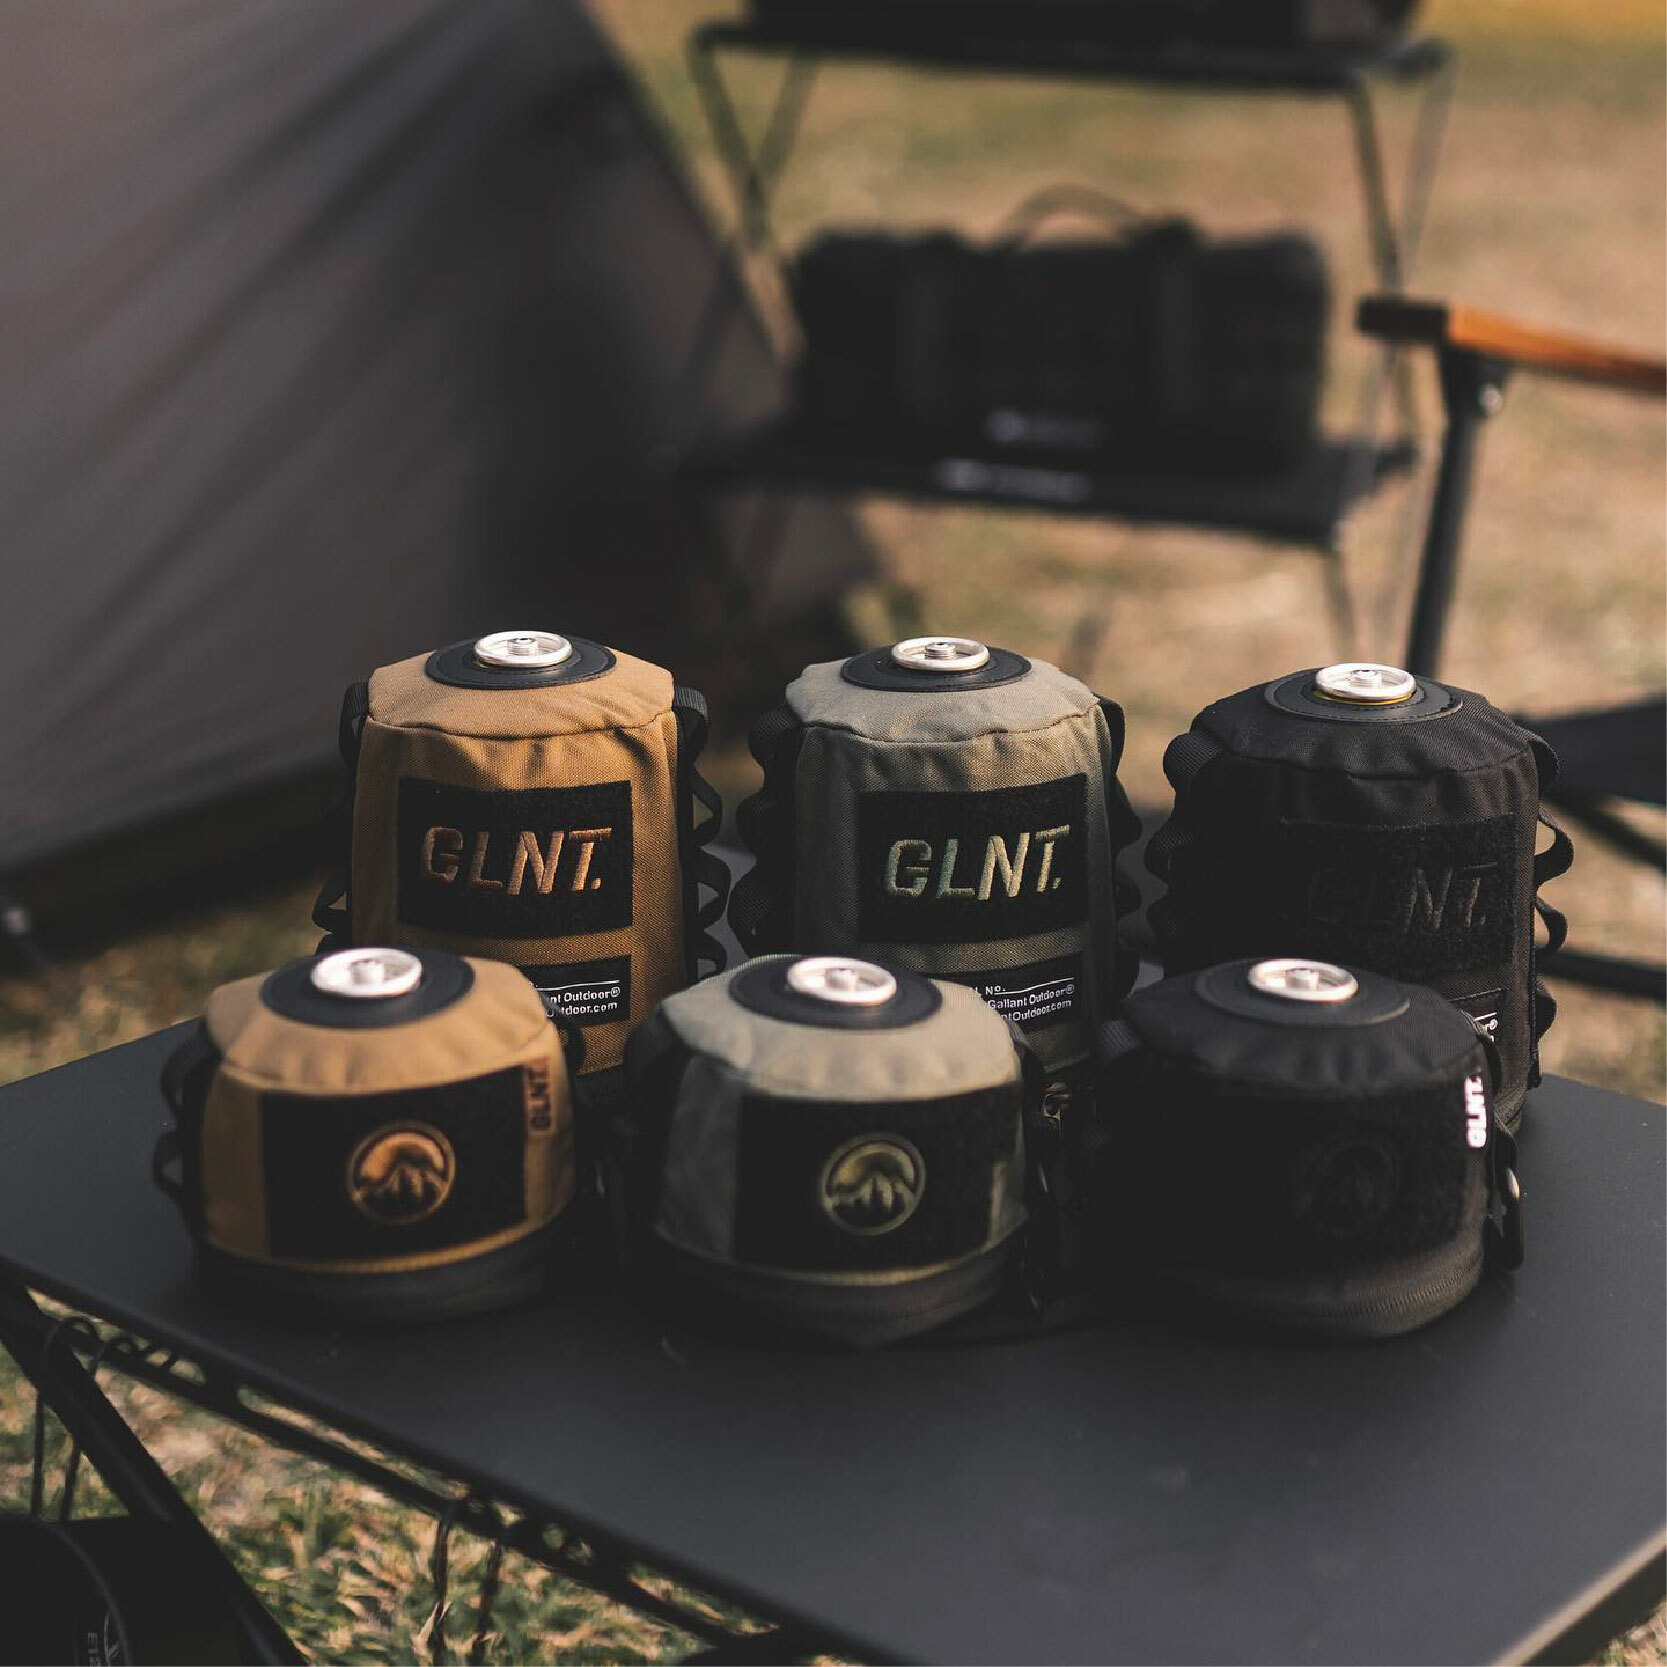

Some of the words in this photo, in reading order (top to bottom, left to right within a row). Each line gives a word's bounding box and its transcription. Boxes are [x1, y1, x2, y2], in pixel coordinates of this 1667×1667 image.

[423, 825, 613, 896] GLNT.
[885, 824, 1072, 900] GLNT.
[560, 1001, 618, 1016] tdoor.com
[987, 997, 1028, 1010] Gallant
